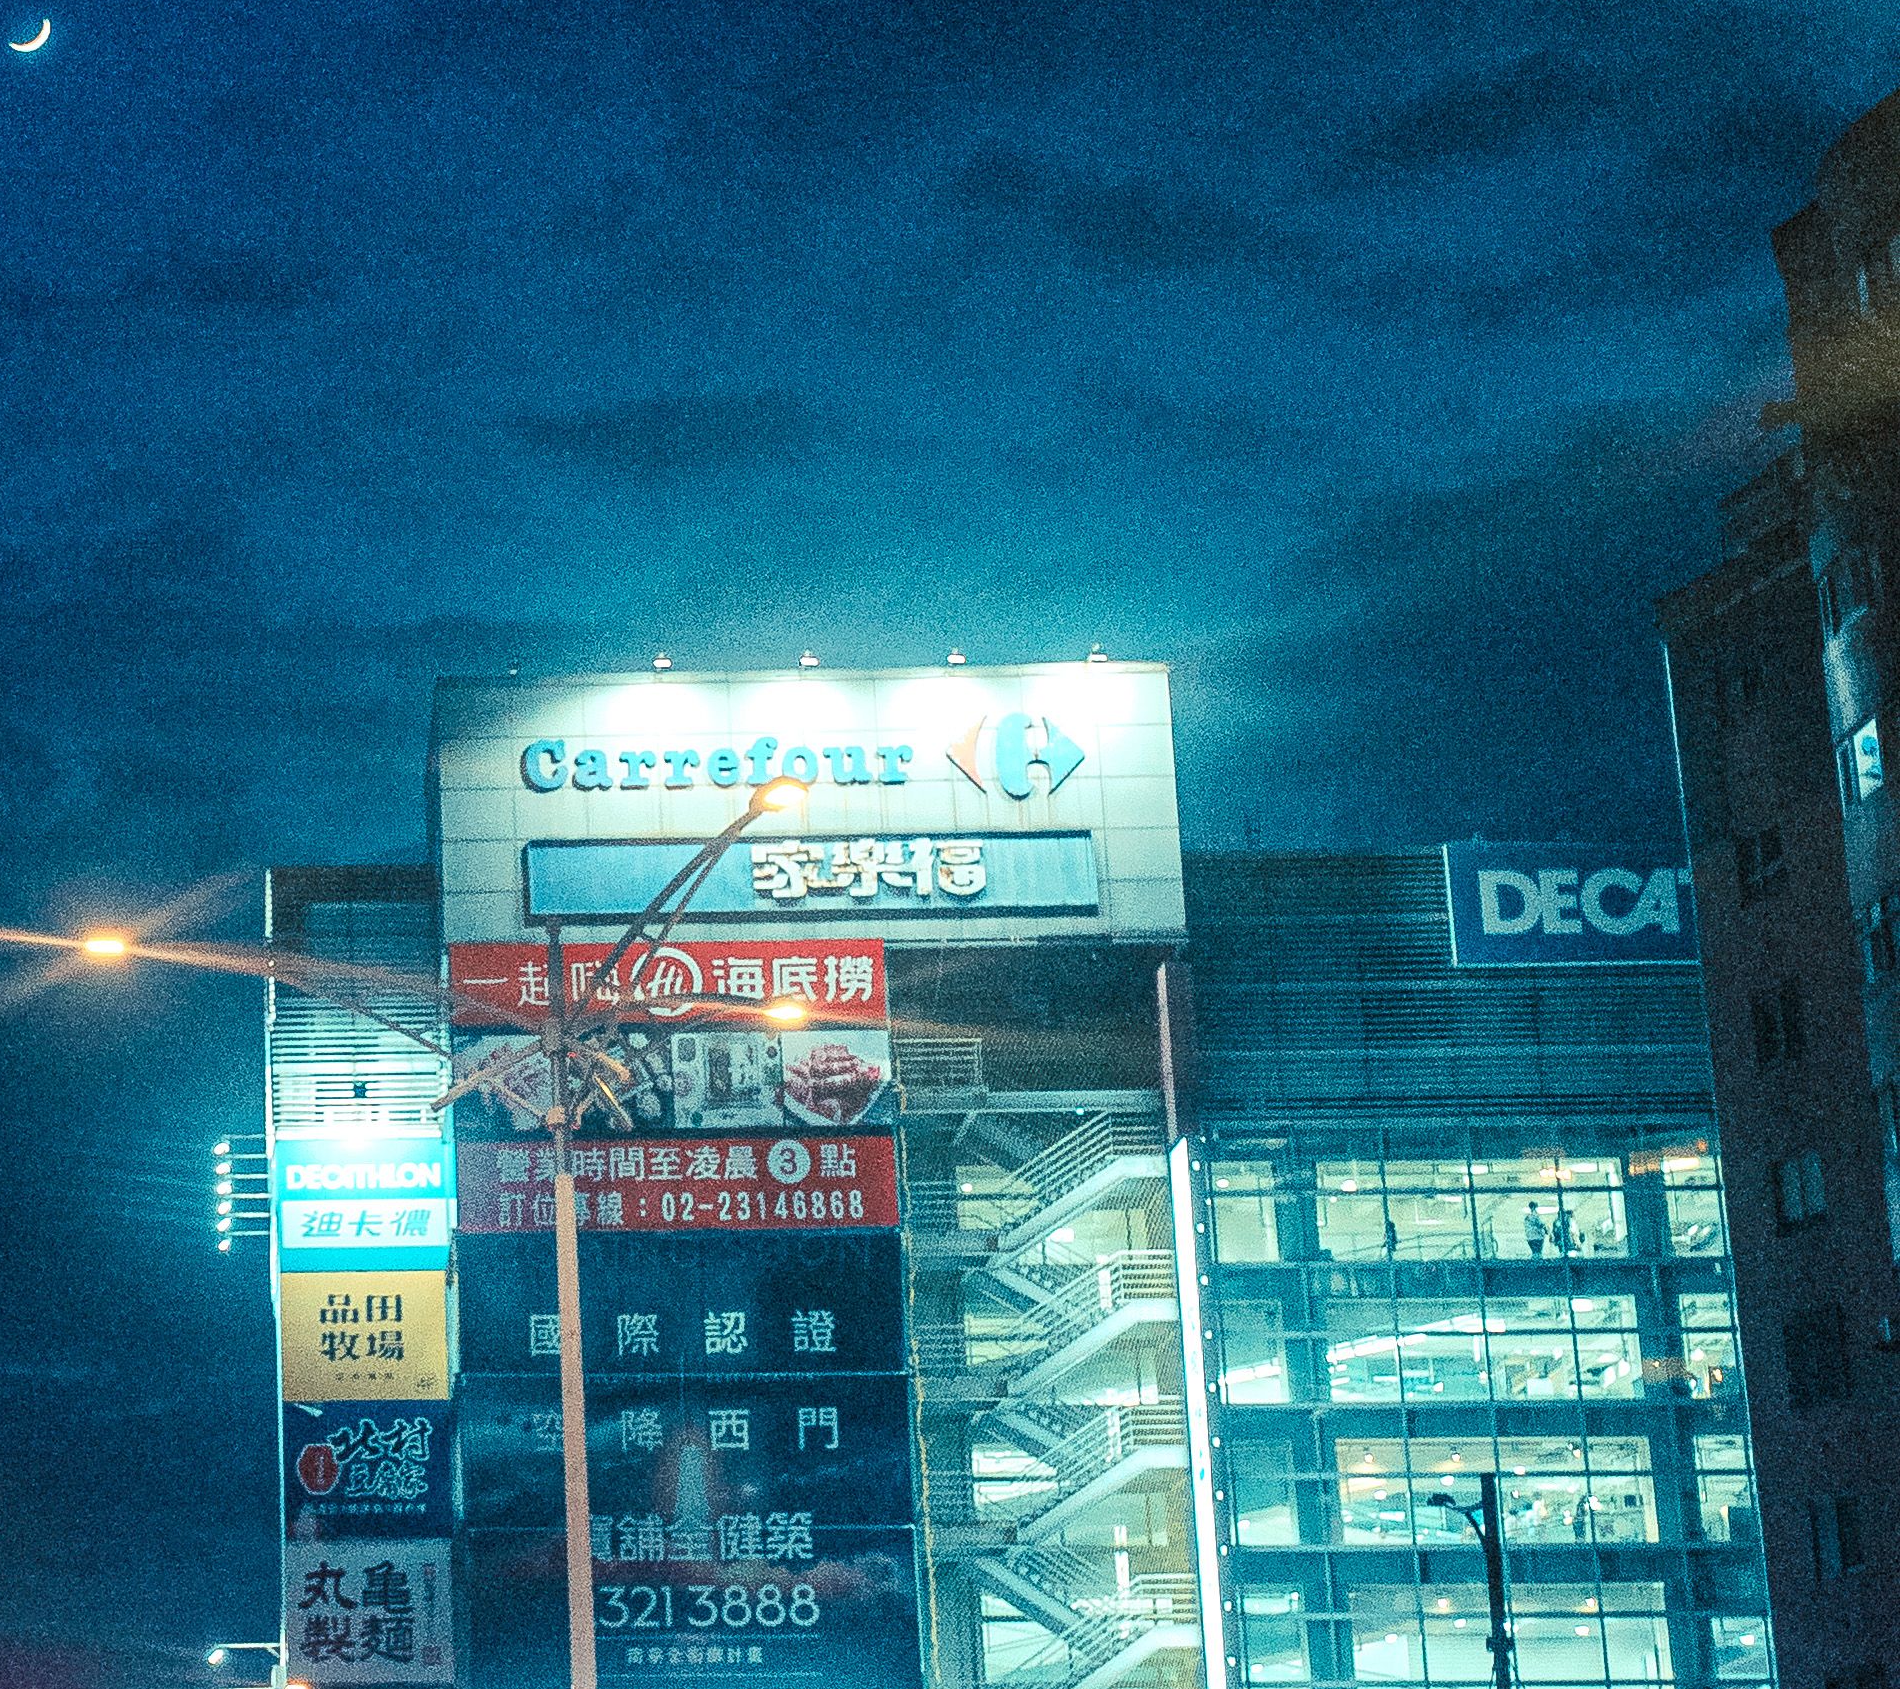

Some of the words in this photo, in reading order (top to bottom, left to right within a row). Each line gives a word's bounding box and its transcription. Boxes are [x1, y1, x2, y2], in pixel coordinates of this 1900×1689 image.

[521, 735, 915, 793] Carrefour
[751, 838, 988, 899] 家樂福
[1476, 866, 1695, 936] DECA
[710, 954, 874, 1003] 海底撈
[285, 1163, 442, 1190] DECATHLON
[302, 1207, 432, 1238] 迪卡儂
[660, 1189, 865, 1224] 02-23146868
[319, 1293, 405, 1324] 品田
[320, 1330, 405, 1362] 牧場
[529, 1310, 837, 1357] 國際認證
[687, 1583, 821, 1628] 3888
